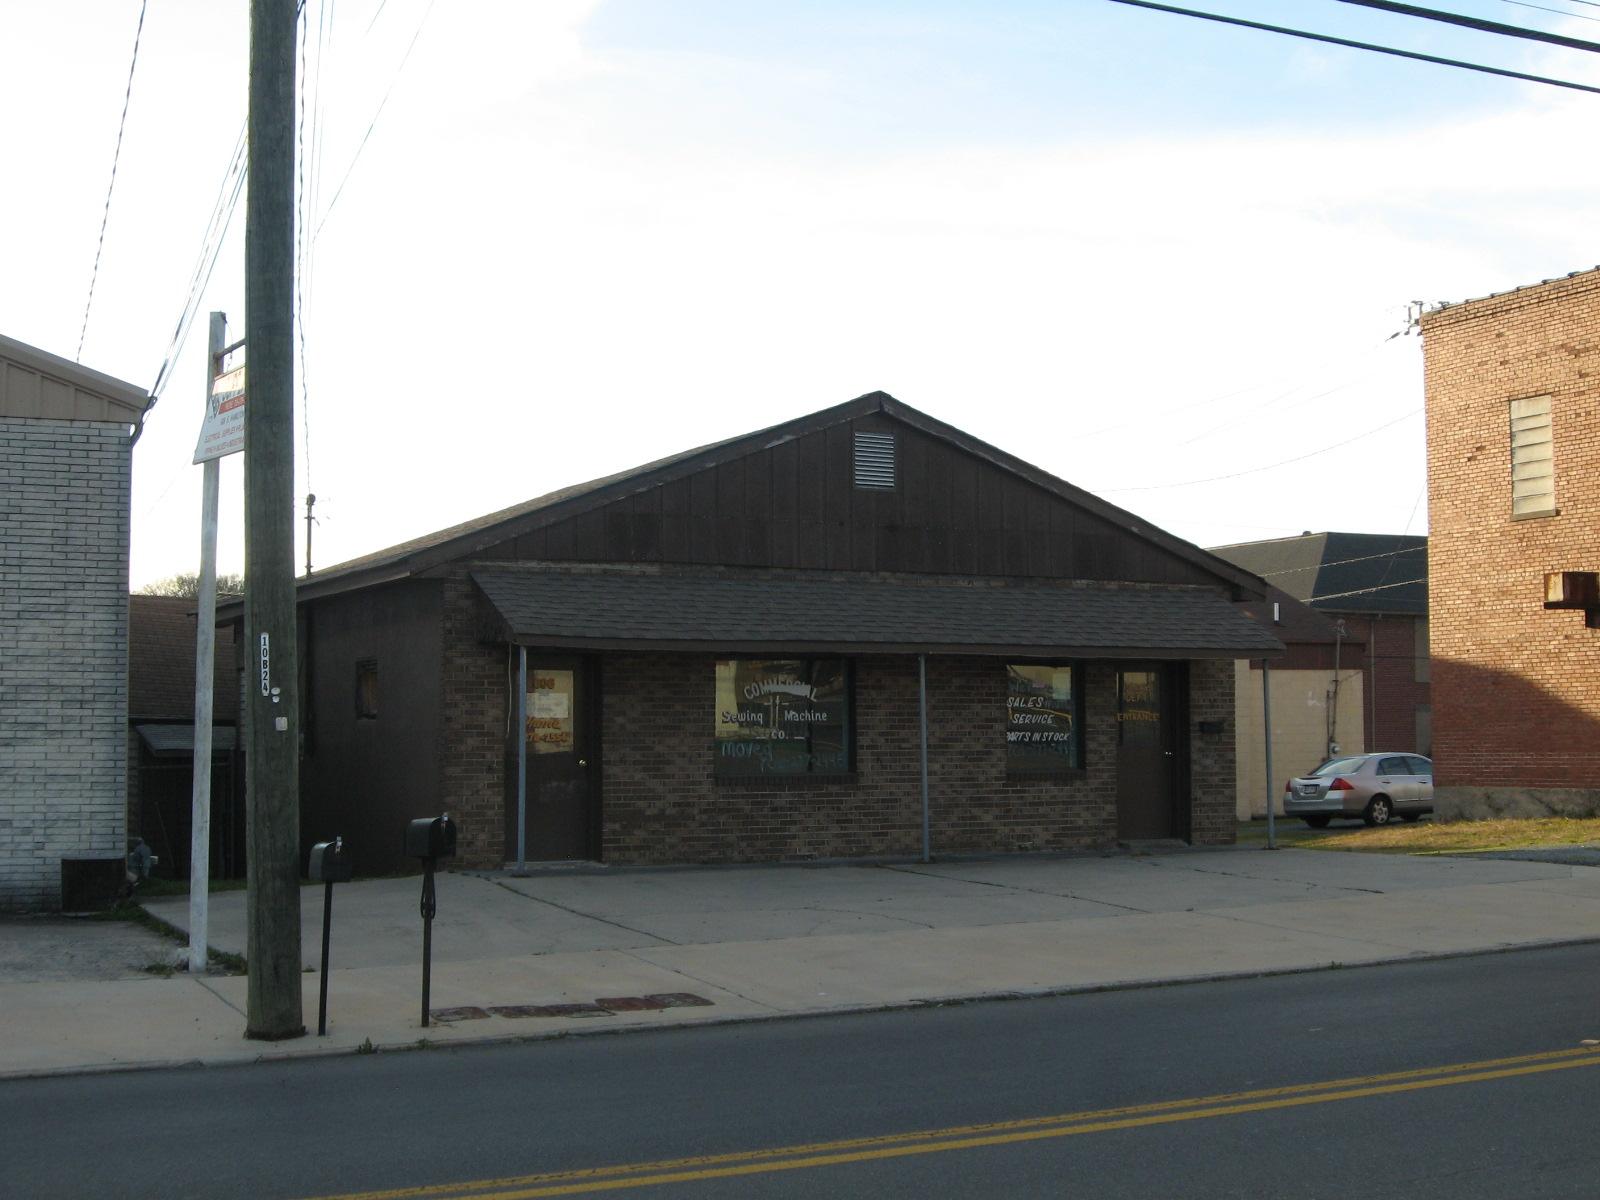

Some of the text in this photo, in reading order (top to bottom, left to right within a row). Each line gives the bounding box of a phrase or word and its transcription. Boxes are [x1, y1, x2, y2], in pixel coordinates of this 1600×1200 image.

[1006, 696, 1044, 708] SALES
[722, 709, 763, 725] Sewing
[784, 709, 828, 721] Machine
[1012, 713, 1056, 725] SERVICE
[1032, 731, 1042, 742] IN
[1041, 731, 1070, 742] STOCK
